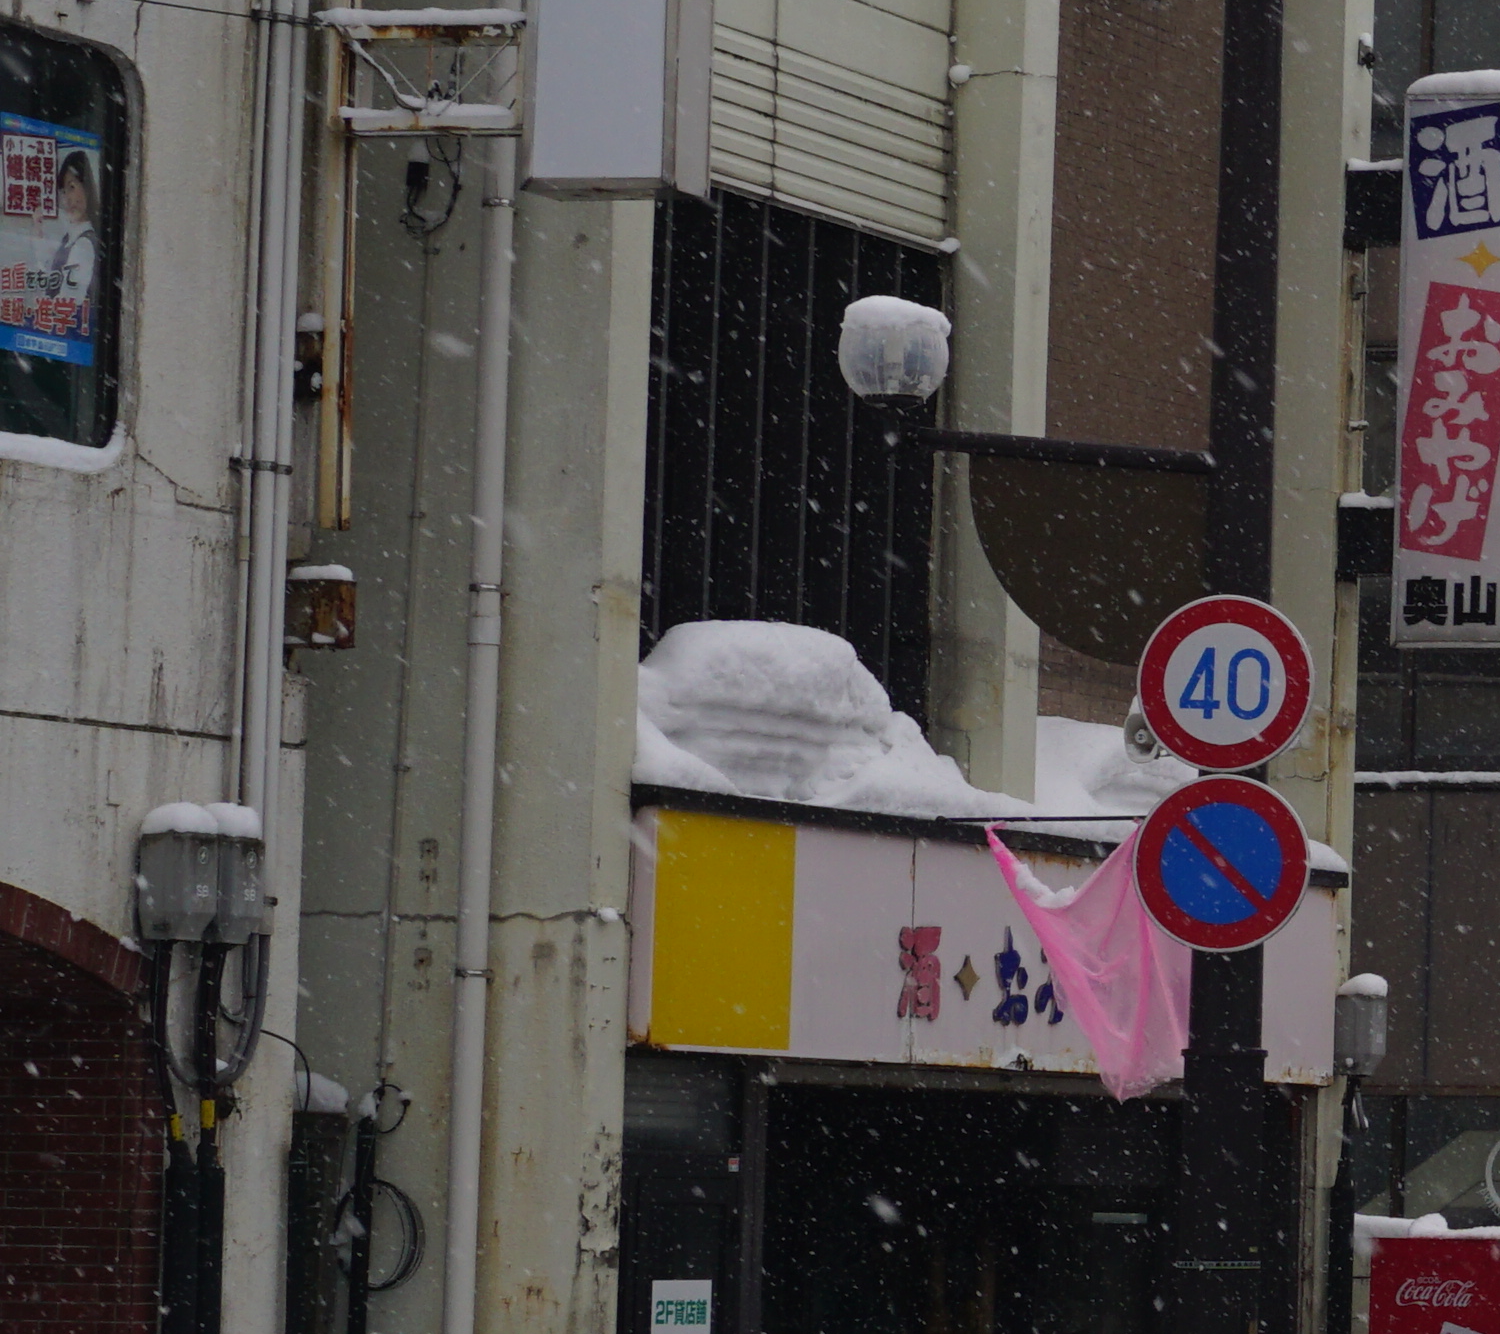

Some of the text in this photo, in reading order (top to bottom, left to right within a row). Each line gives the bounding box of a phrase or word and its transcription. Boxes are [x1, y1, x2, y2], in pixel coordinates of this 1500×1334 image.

[1403, 574, 1498, 628] 奥山
[1178, 648, 1271, 720] 40
[655, 1299, 708, 1326] 2F貸店舗
[1395, 1278, 1477, 1308] Coca-Cola
